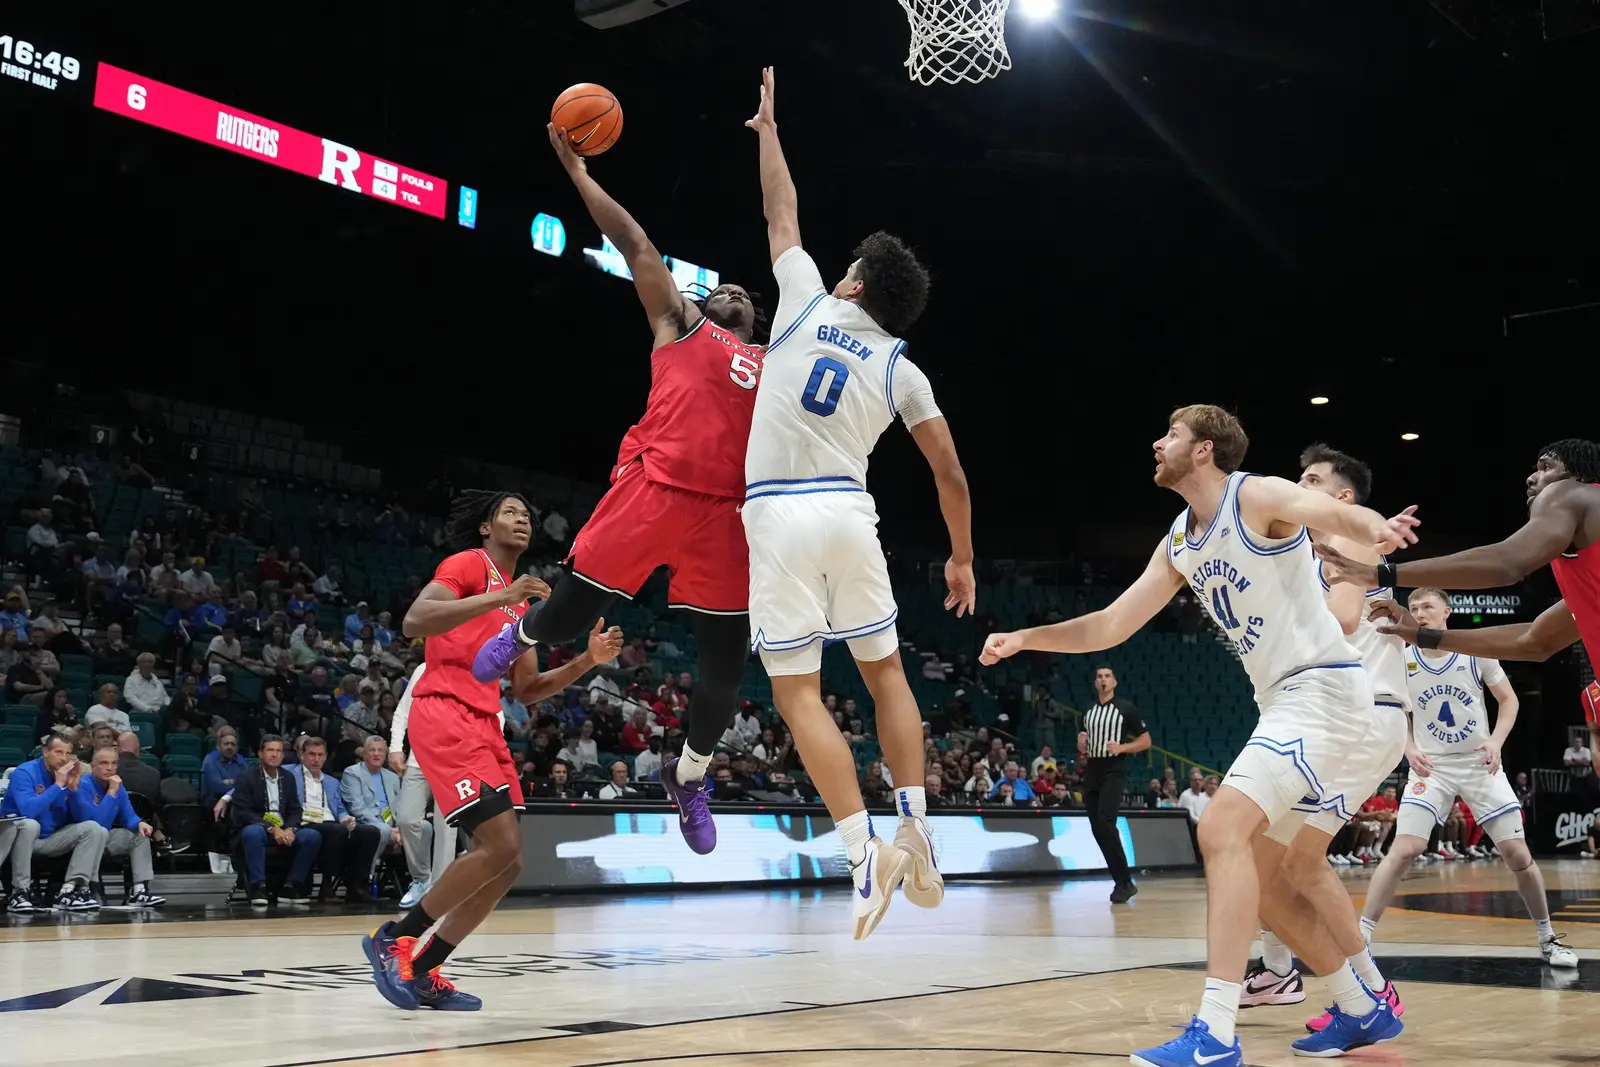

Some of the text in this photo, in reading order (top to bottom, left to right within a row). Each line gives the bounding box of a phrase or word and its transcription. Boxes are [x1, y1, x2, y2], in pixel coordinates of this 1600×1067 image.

[0, 34, 80, 81] 16:49
[1, 61, 58, 90] FIRST HALF
[127, 84, 147, 110] 6
[216, 111, 280, 158] RUTGERS
[318, 138, 362, 193] R
[401, 173, 434, 192] FOULS
[401, 190, 422, 205] TOL
[711, 331, 764, 363] RUTGE
[817, 324, 873, 362] GREEN
[728, 352, 759, 390] 5
[801, 356, 850, 417] 0
[1476, 594, 1521, 606] GRAND
[1486, 607, 1515, 615] ARENA
[1418, 685, 1473, 710] CREIGHTON
[1437, 701, 1456, 727] 4
[1427, 719, 1477, 743] BLUEJAYS
[455, 779, 476, 800] R
[1555, 808, 1600, 840] GHO
